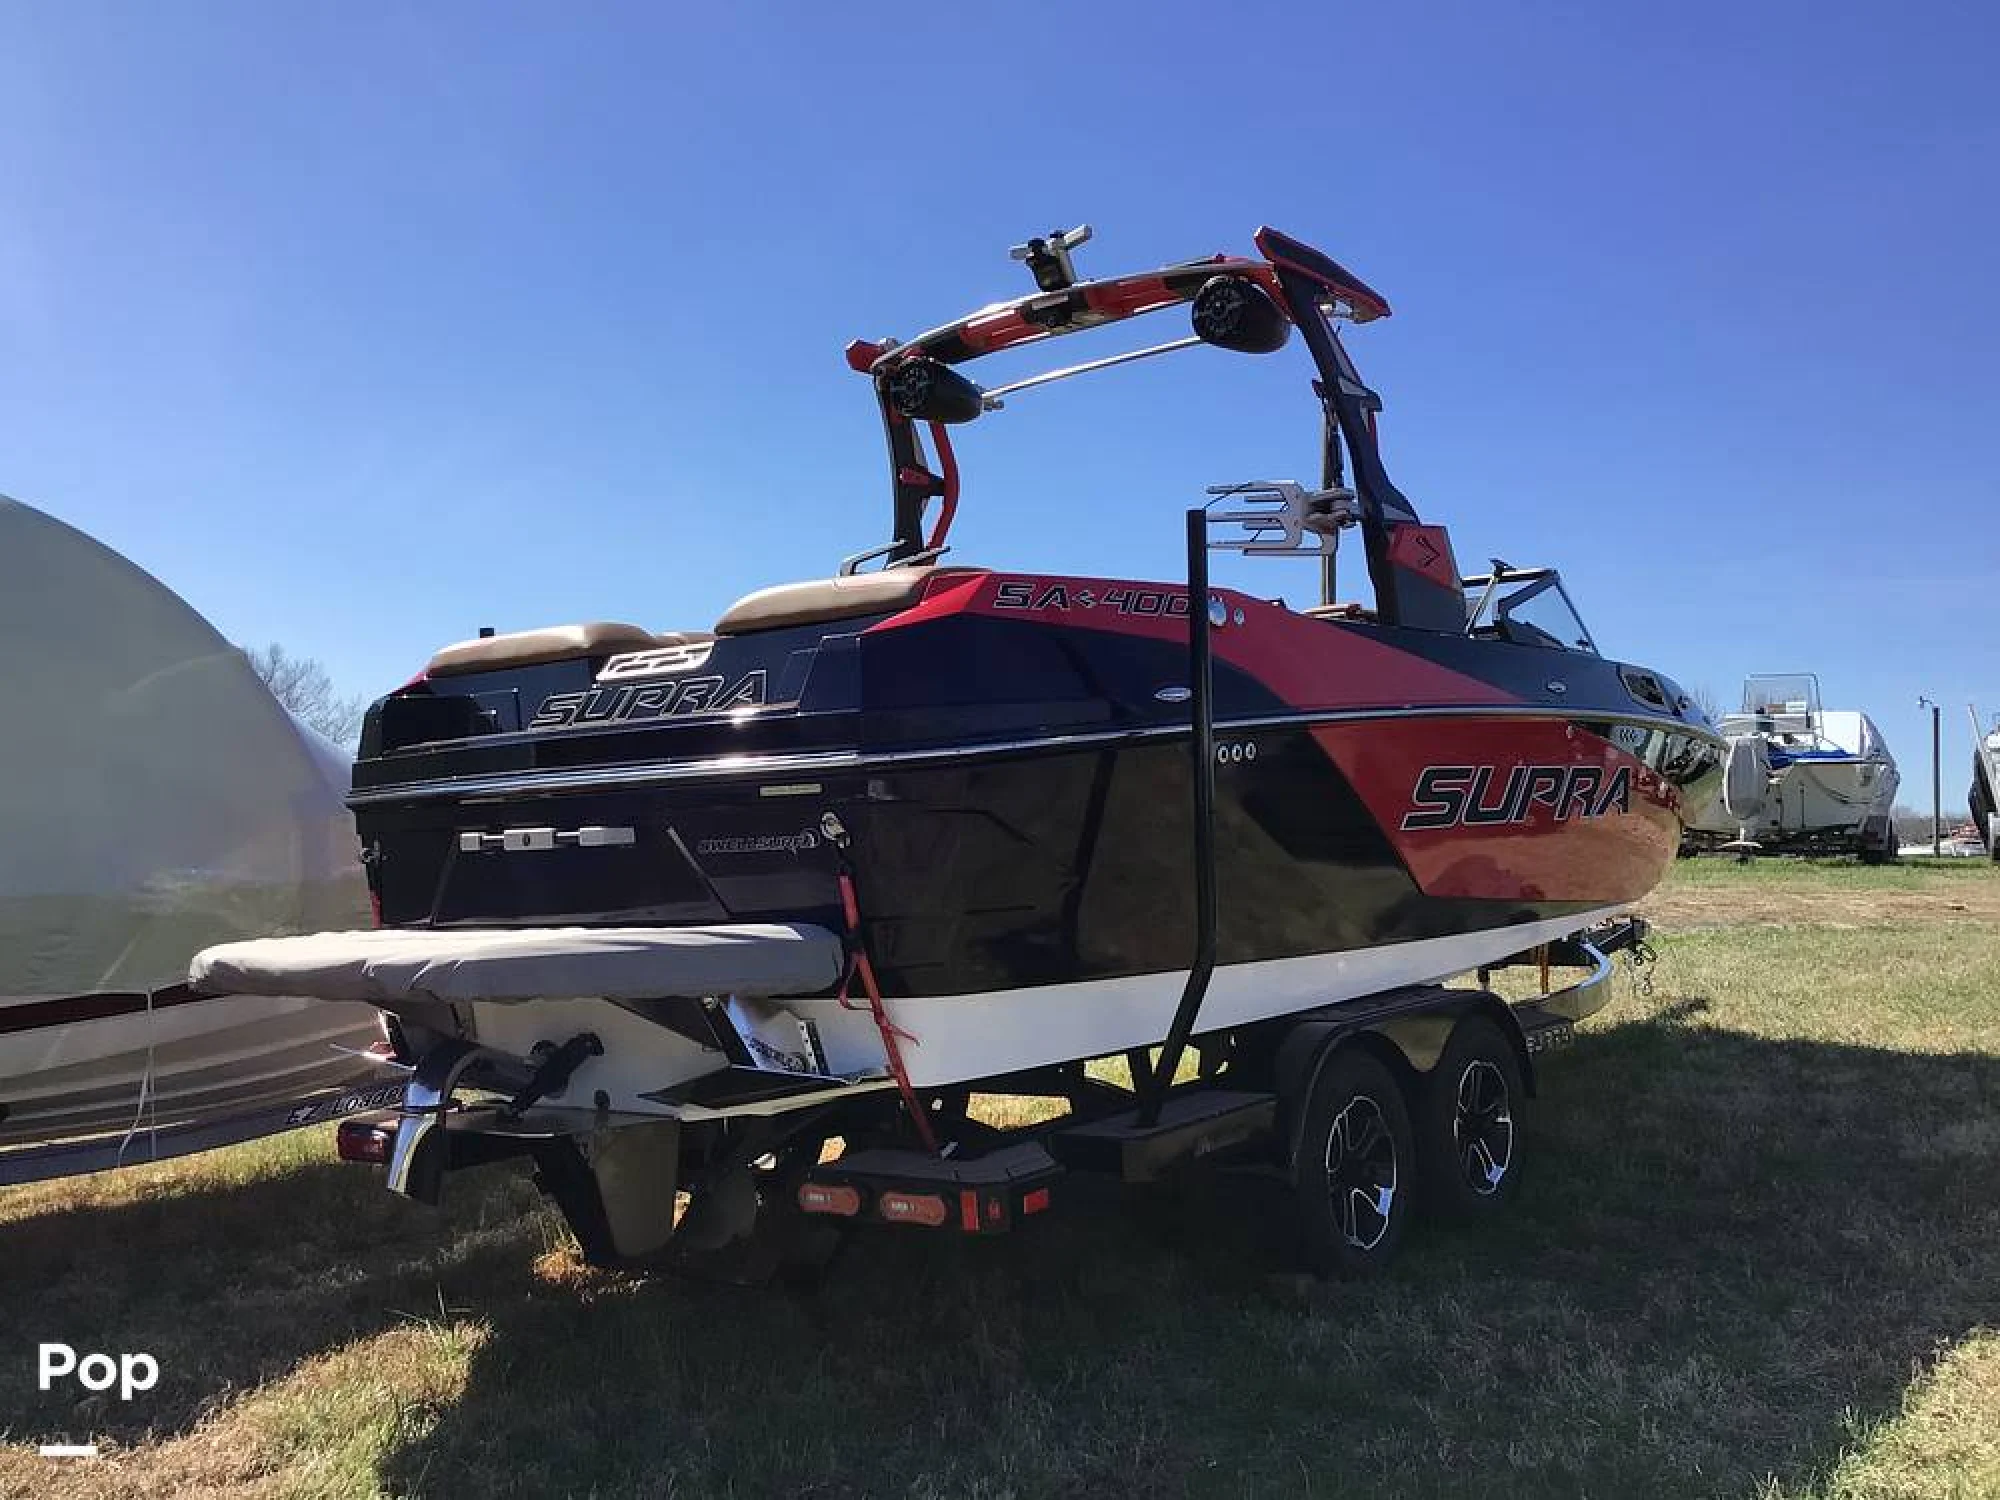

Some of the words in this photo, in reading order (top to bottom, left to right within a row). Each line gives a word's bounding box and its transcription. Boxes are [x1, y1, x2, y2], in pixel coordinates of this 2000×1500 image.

[993, 582, 1070, 611] SA
[528, 670, 767, 732] SUPRA
[1400, 766, 1631, 830] SUPRA
